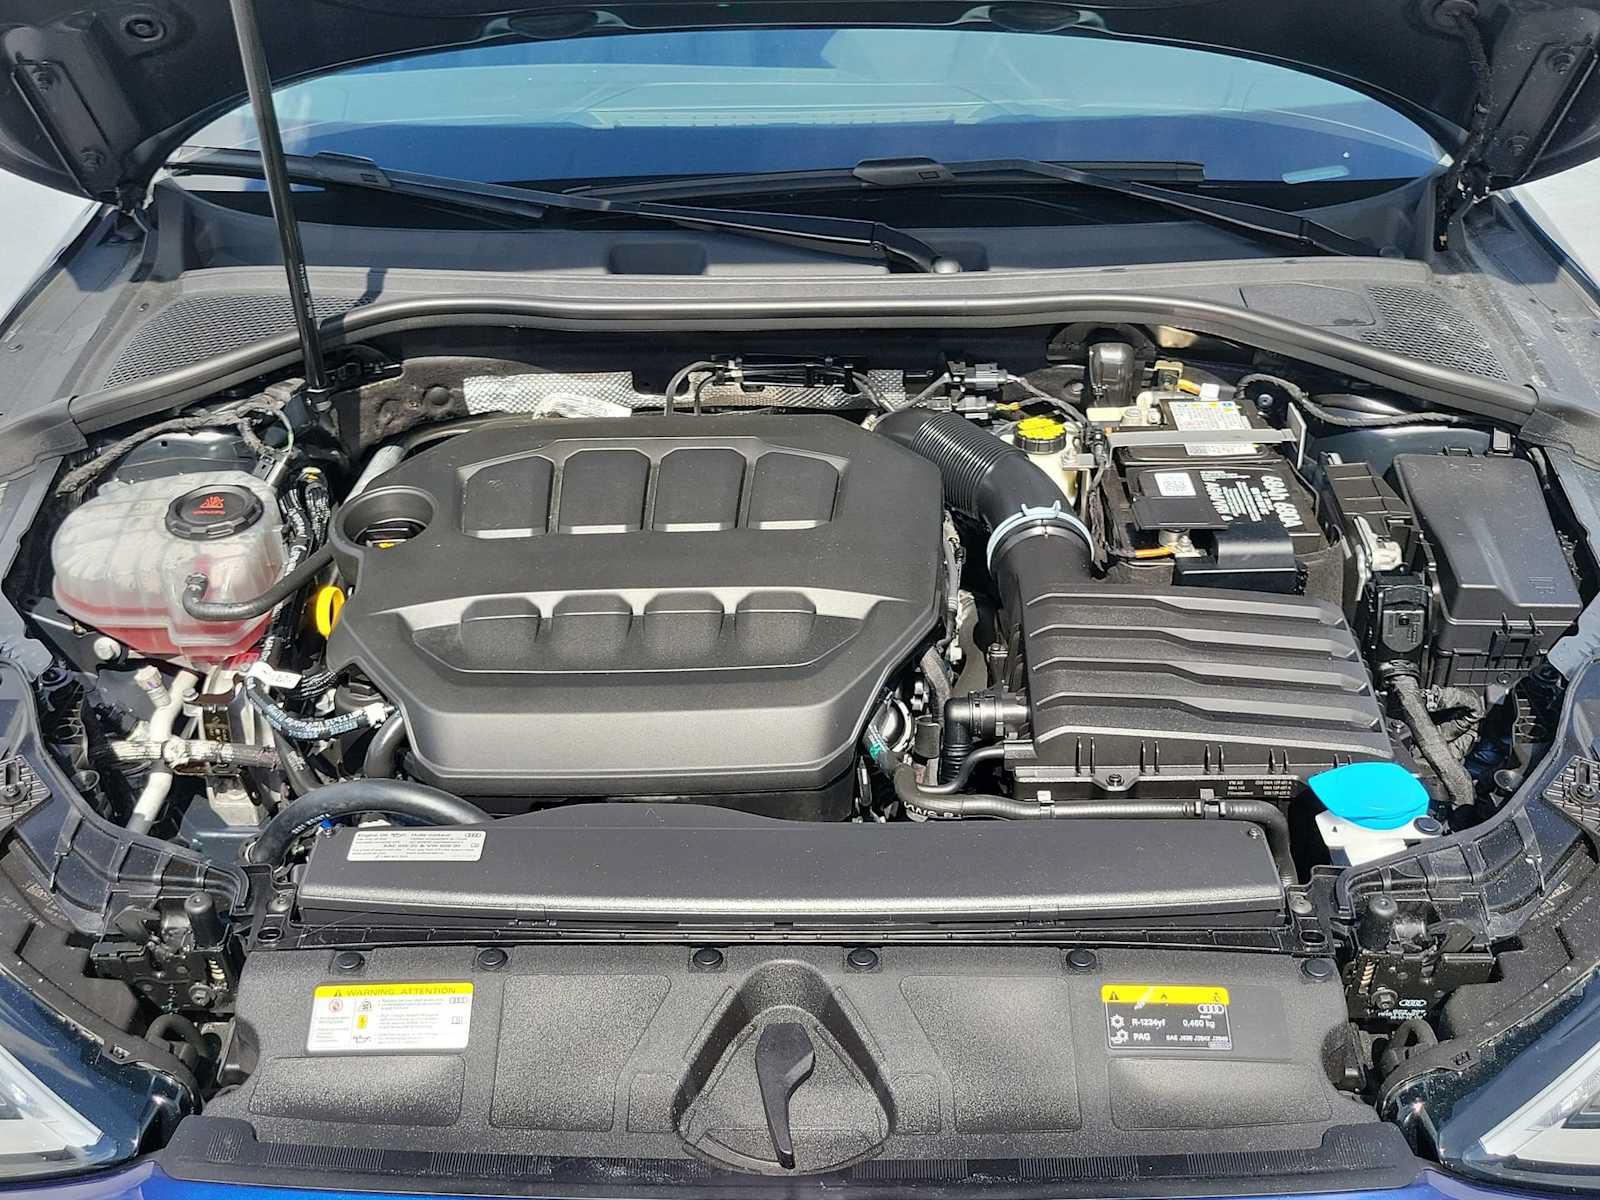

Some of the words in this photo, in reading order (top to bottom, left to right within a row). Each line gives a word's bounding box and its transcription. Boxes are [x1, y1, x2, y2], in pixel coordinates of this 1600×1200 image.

[346, 989, 394, 997] WARNING
[400, 987, 456, 995] ATTENTION
[1131, 1018, 1166, 1029] R-1234yf
[1133, 1032, 1151, 1041] PAG
